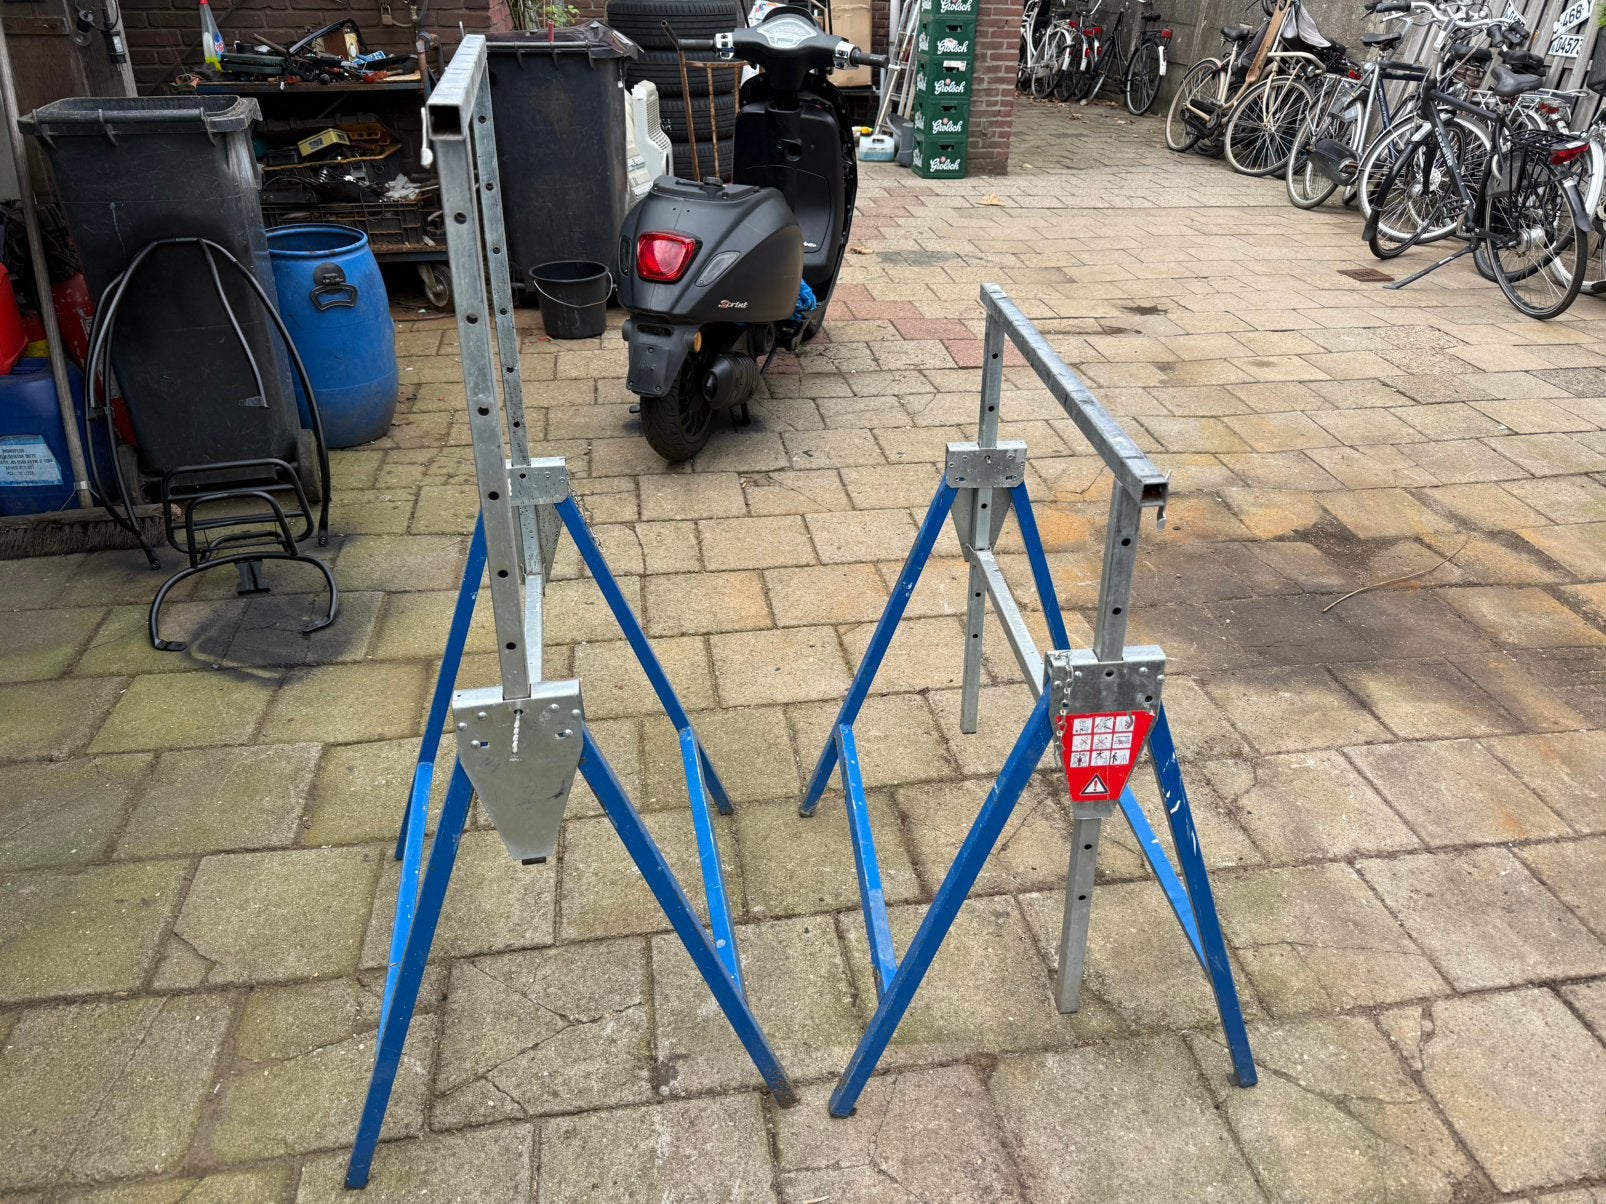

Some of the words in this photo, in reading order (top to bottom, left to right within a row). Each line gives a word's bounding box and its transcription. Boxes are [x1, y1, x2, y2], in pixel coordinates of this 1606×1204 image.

[934, 80, 965, 95] Grolsch
[932, 119, 963, 134] Grolsch
[1435, 127, 1453, 167] Gazelle
[929, 158, 961, 172] Grolsch
[718, 300, 748, 309] Sprint
